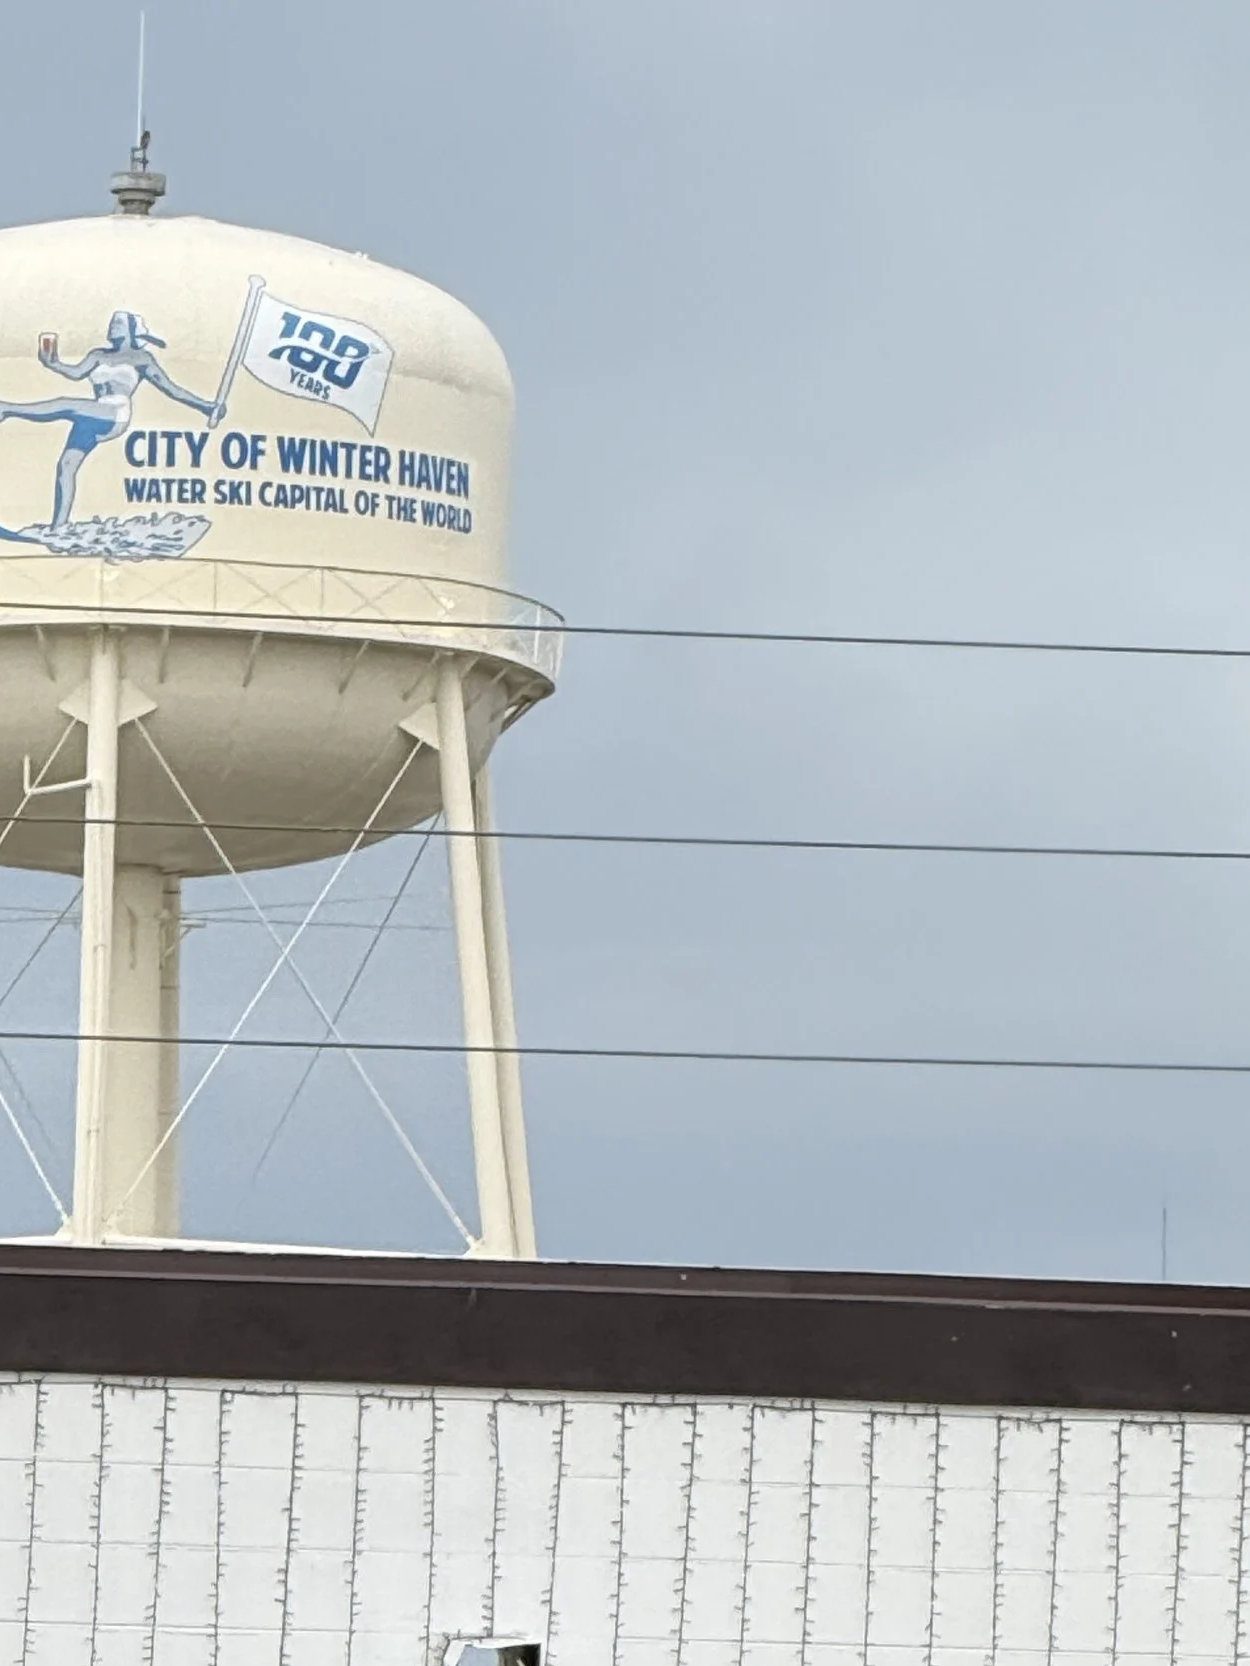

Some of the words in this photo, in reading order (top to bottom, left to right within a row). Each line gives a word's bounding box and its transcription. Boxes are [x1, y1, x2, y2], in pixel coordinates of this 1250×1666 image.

[290, 368, 332, 401] YEARS
[124, 430, 210, 468] CITY
[221, 432, 267, 471] OF
[277, 435, 391, 485] WINTER
[399, 449, 470, 500] HAVEN
[124, 477, 207, 504] WATER
[214, 479, 253, 506] SKI
[258, 481, 349, 515] CAPITAL
[354, 490, 380, 518] OF
[385, 494, 417, 524] THE
[421, 499, 472, 535] WORLD
